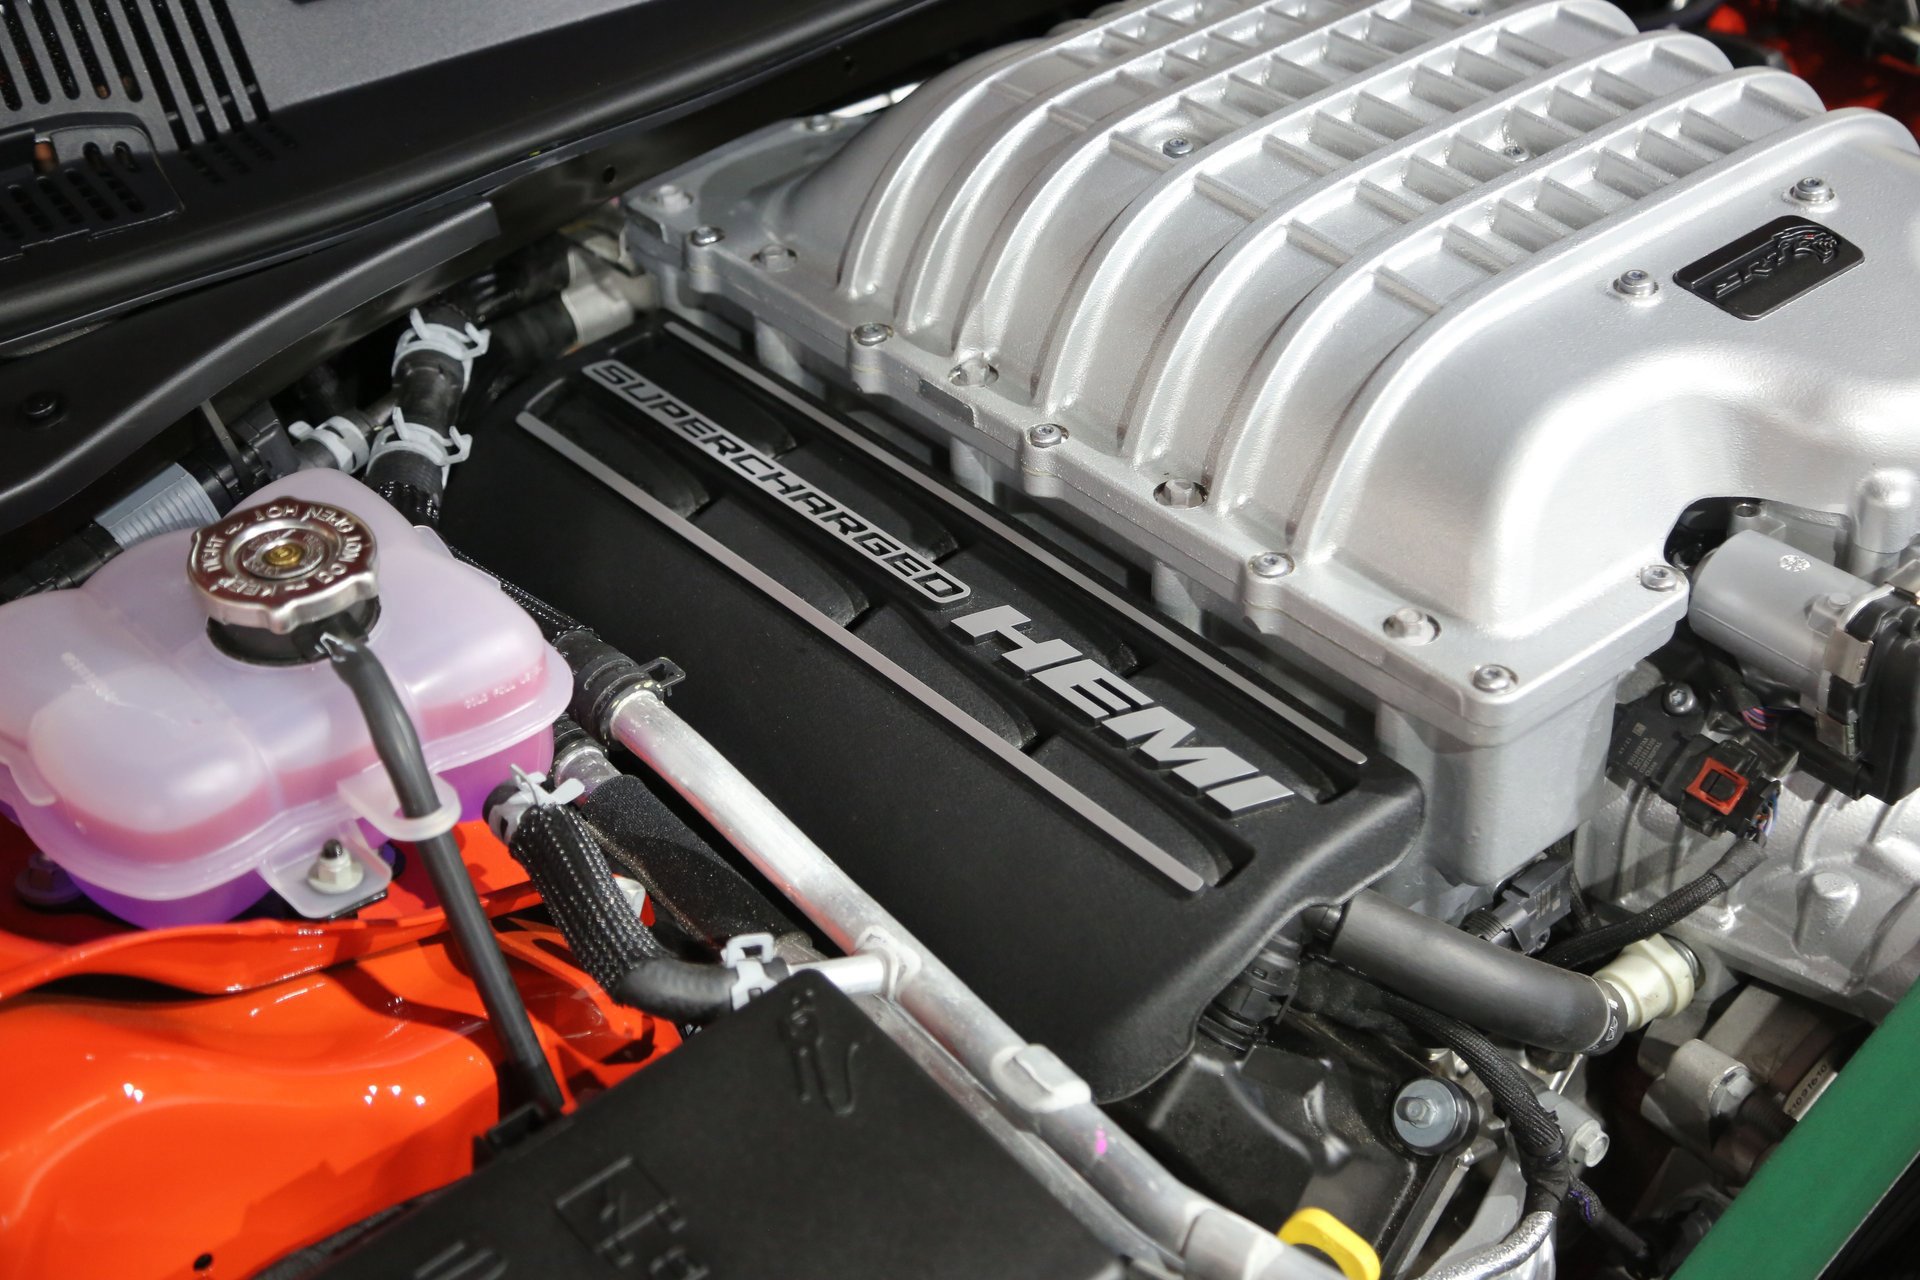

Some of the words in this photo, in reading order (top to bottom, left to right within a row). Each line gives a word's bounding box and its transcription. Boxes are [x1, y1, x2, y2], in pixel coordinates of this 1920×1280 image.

[255, 505, 298, 521] HOT
[300, 507, 354, 532] OPEN
[599, 364, 966, 599] SUPERCHARGED
[950, 604, 1295, 815] HEMI
